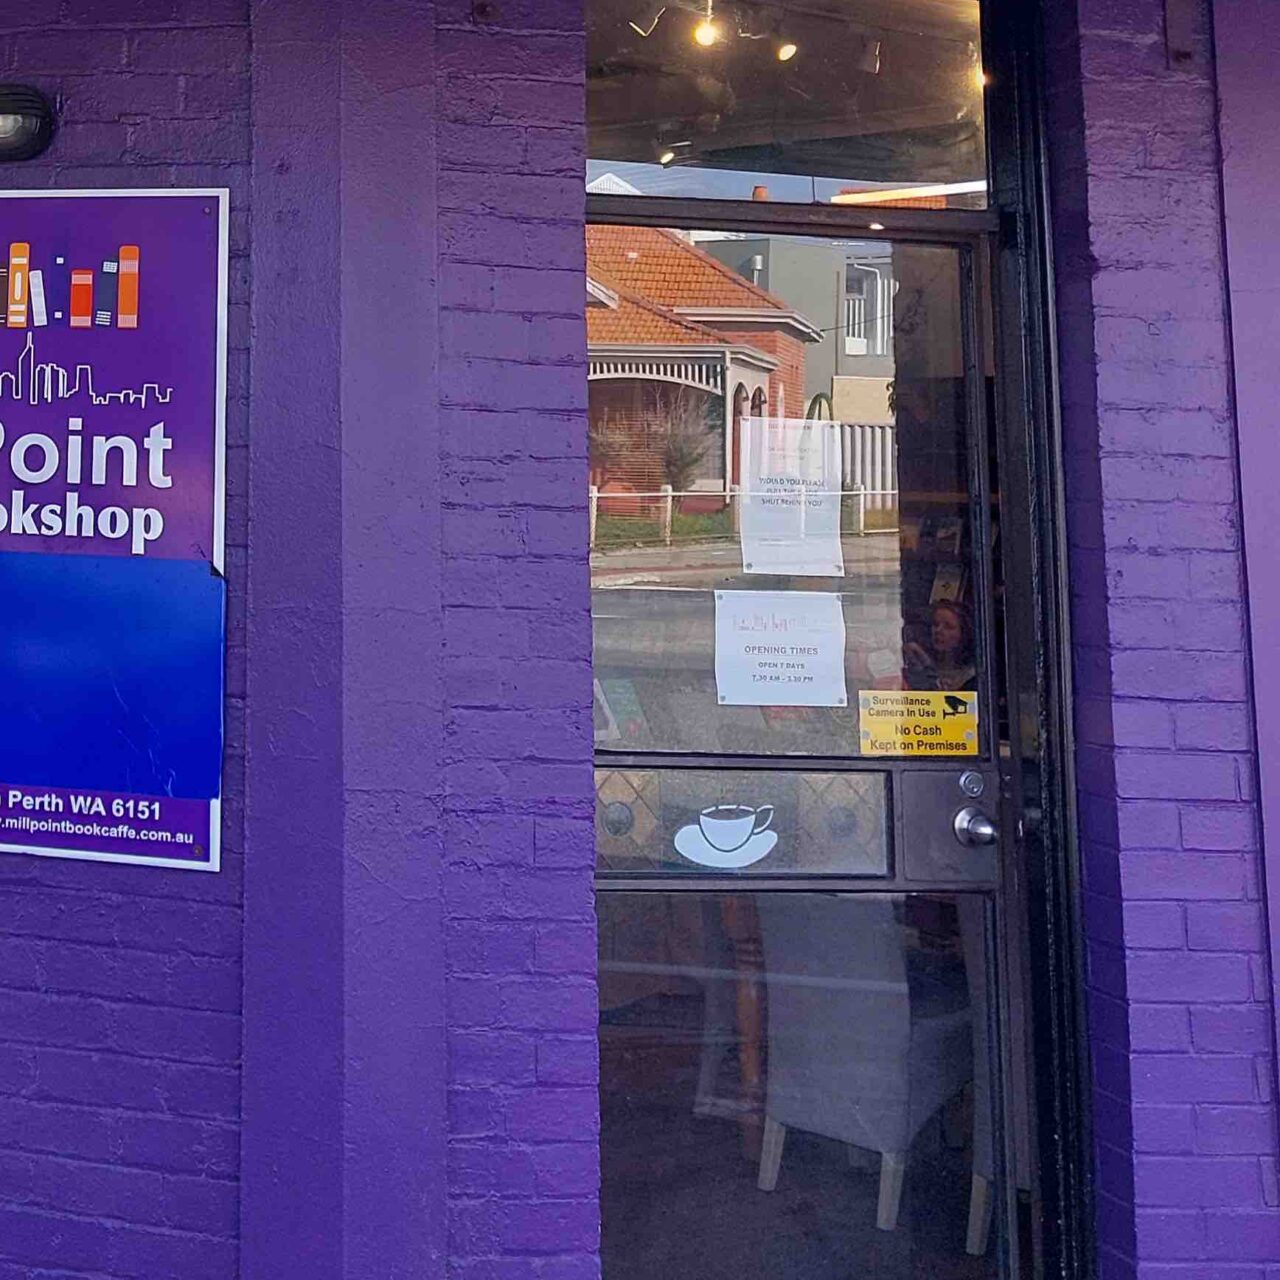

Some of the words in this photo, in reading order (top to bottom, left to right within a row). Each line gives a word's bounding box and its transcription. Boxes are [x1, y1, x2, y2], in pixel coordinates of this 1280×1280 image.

[744, 645, 787, 655] OPENING
[789, 646, 819, 655] TIMES
[758, 661, 778, 669] OPEN
[872, 695, 932, 706] Surveillance
[868, 707, 905, 718] Camera
[907, 708, 916, 718] In
[918, 708, 937, 718] Use
[895, 723, 911, 736] No
[913, 723, 942, 736] Cash
[870, 738, 898, 753] Kept
[899, 740, 914, 751] on
[916, 739, 968, 751] Premises
[9, 790, 65, 814] Perth
[69, 795, 106, 817] WA
[111, 798, 161, 821] 6151
